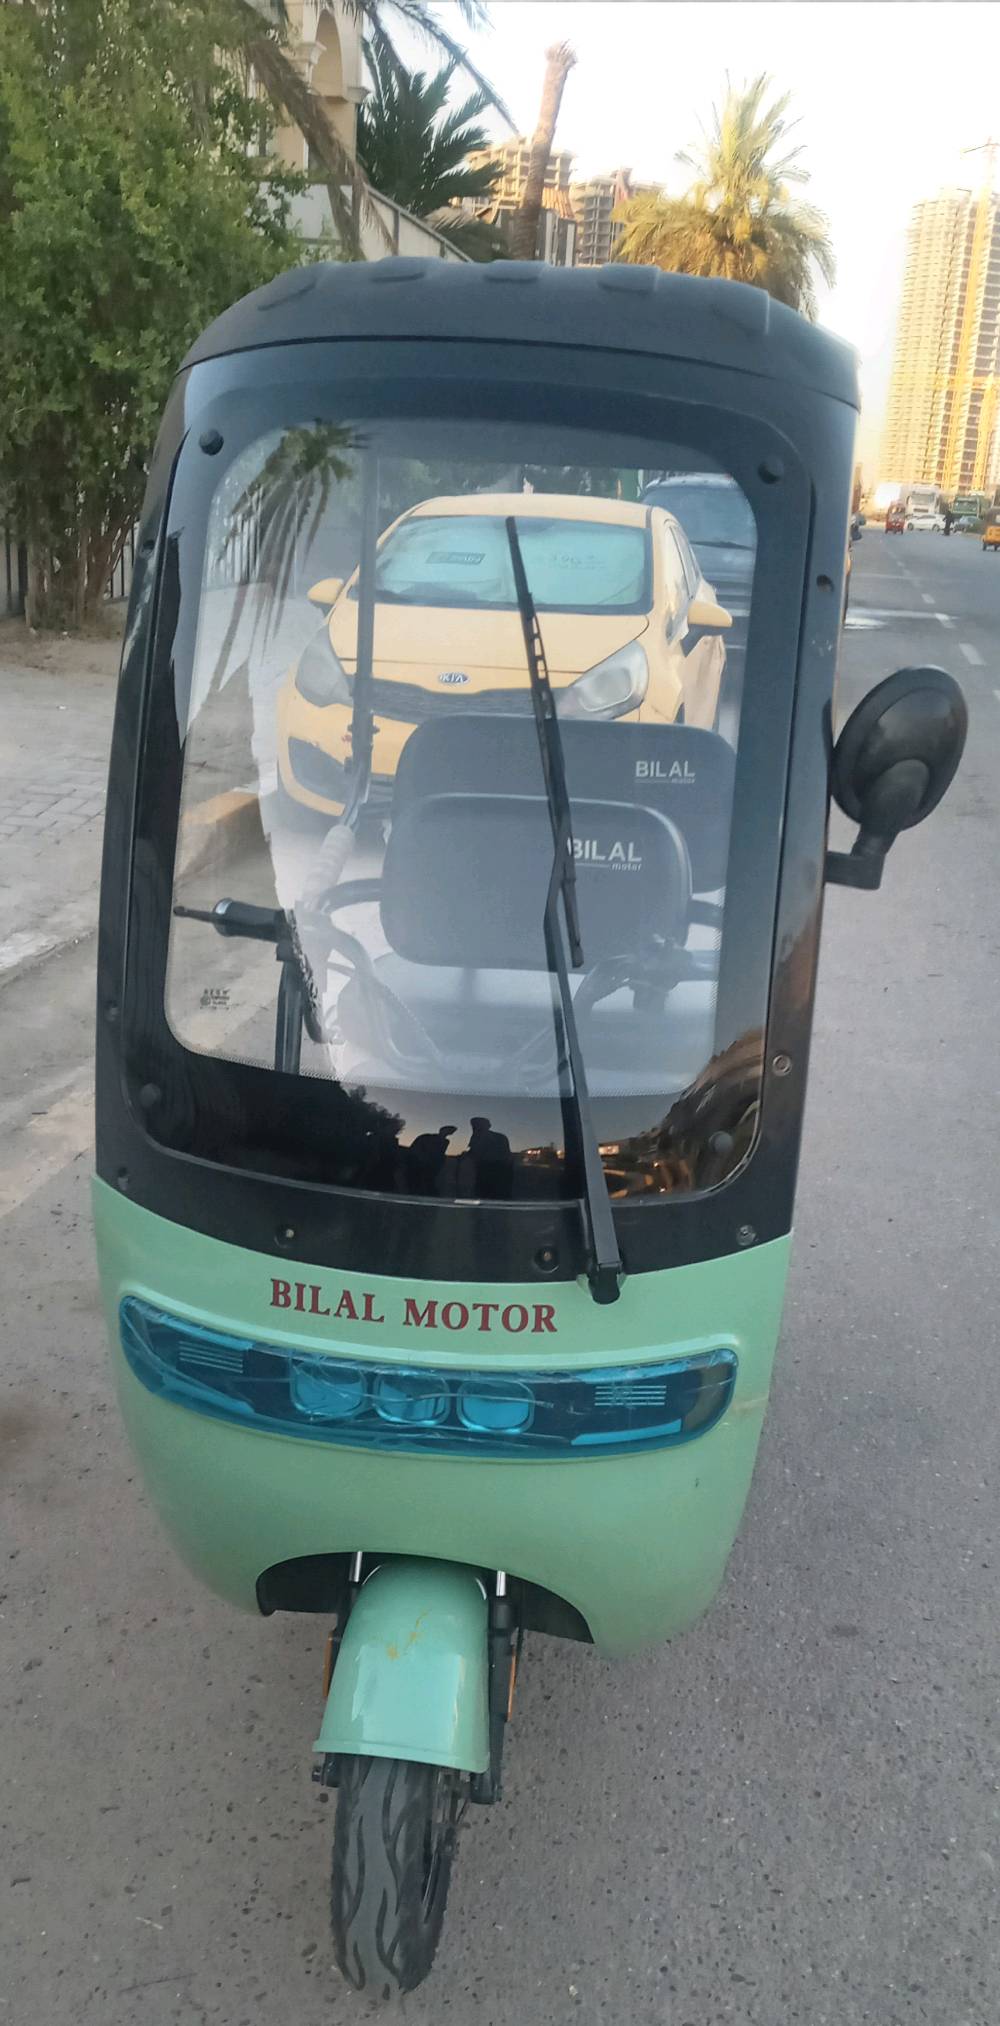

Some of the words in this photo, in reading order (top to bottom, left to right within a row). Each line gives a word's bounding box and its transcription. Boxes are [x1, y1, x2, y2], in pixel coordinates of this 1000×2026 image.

[635, 760, 696, 777] BILAL
[567, 837, 642, 861] BILAL
[611, 863, 641, 872] motor
[270, 1278, 385, 1323] BILAL
[403, 1298, 558, 1333] MOTOR
